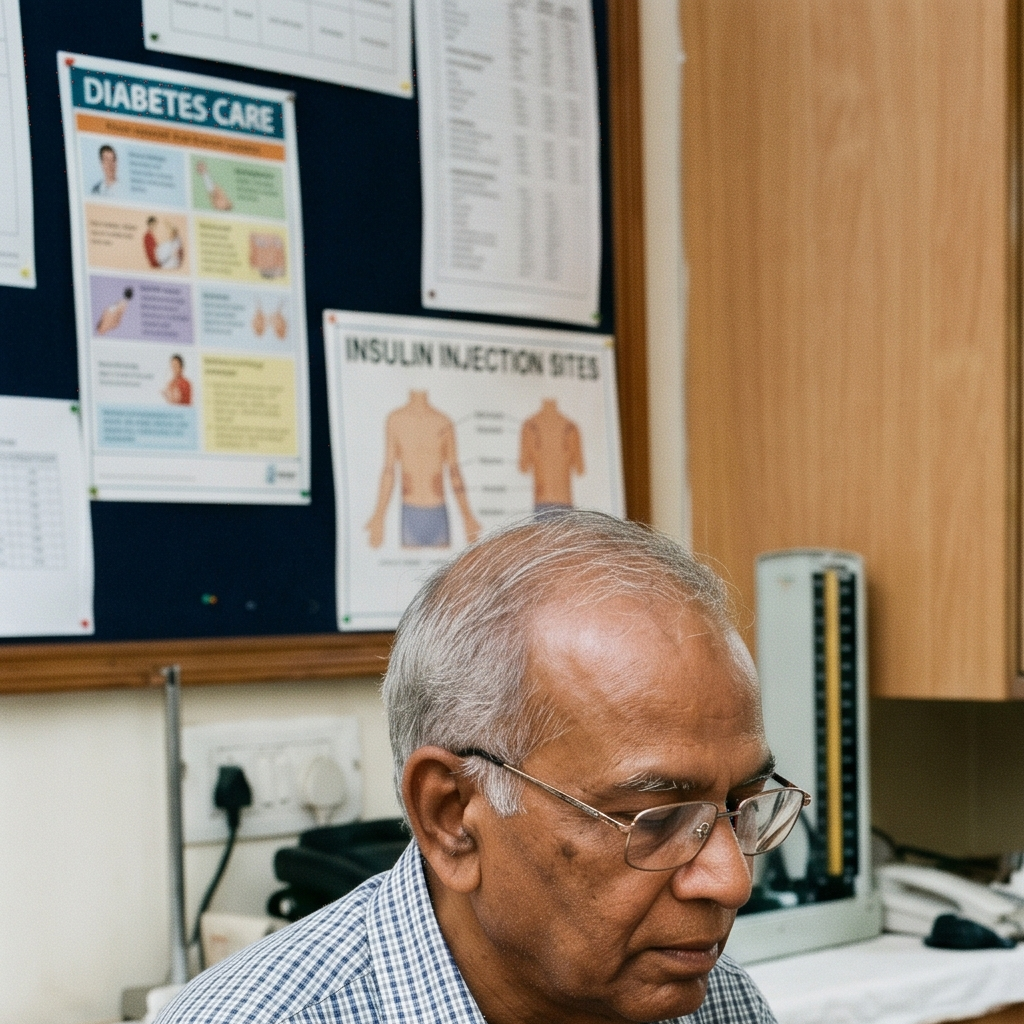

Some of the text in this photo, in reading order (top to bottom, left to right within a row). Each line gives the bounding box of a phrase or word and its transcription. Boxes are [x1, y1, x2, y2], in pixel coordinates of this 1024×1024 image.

[83, 76, 276, 134] DIABETES CARE
[346, 337, 600, 381] INSULIN INJECTION SITES
